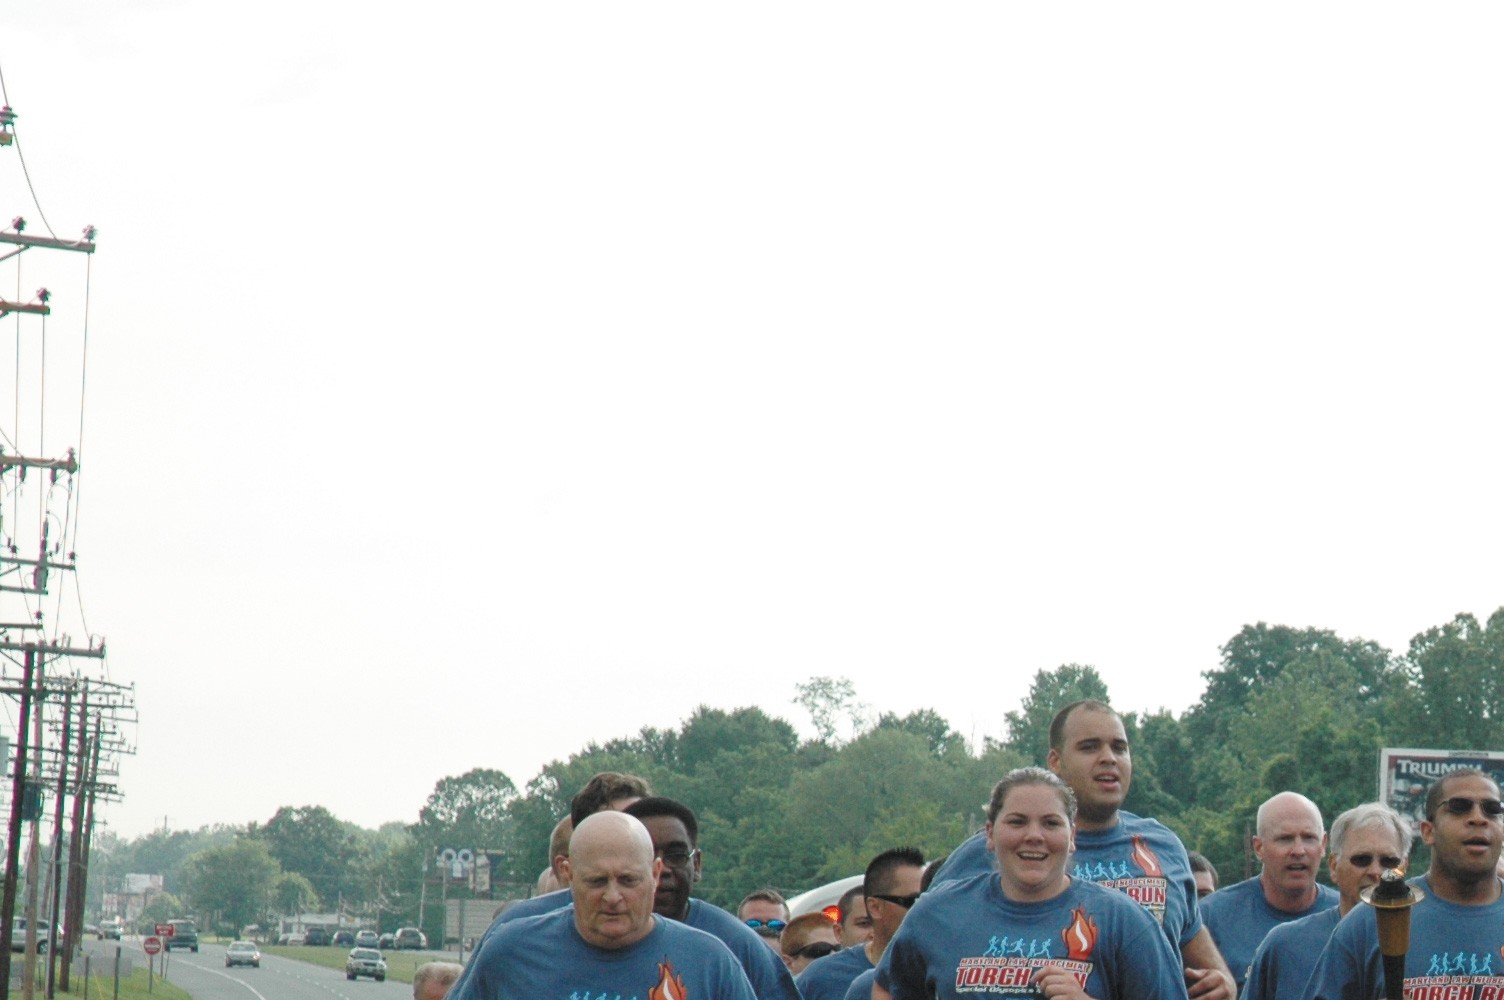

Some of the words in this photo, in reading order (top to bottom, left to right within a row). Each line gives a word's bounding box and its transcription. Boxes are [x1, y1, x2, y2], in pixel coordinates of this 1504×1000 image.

[1127, 887, 1166, 905] RUN
[960, 957, 1007, 967] MARYLAND
[1007, 958, 1027, 967] LAW
[956, 966, 1032, 988] TORCH
[1403, 977, 1450, 986] MARYLAND
[1450, 976, 1470, 985] LAW
